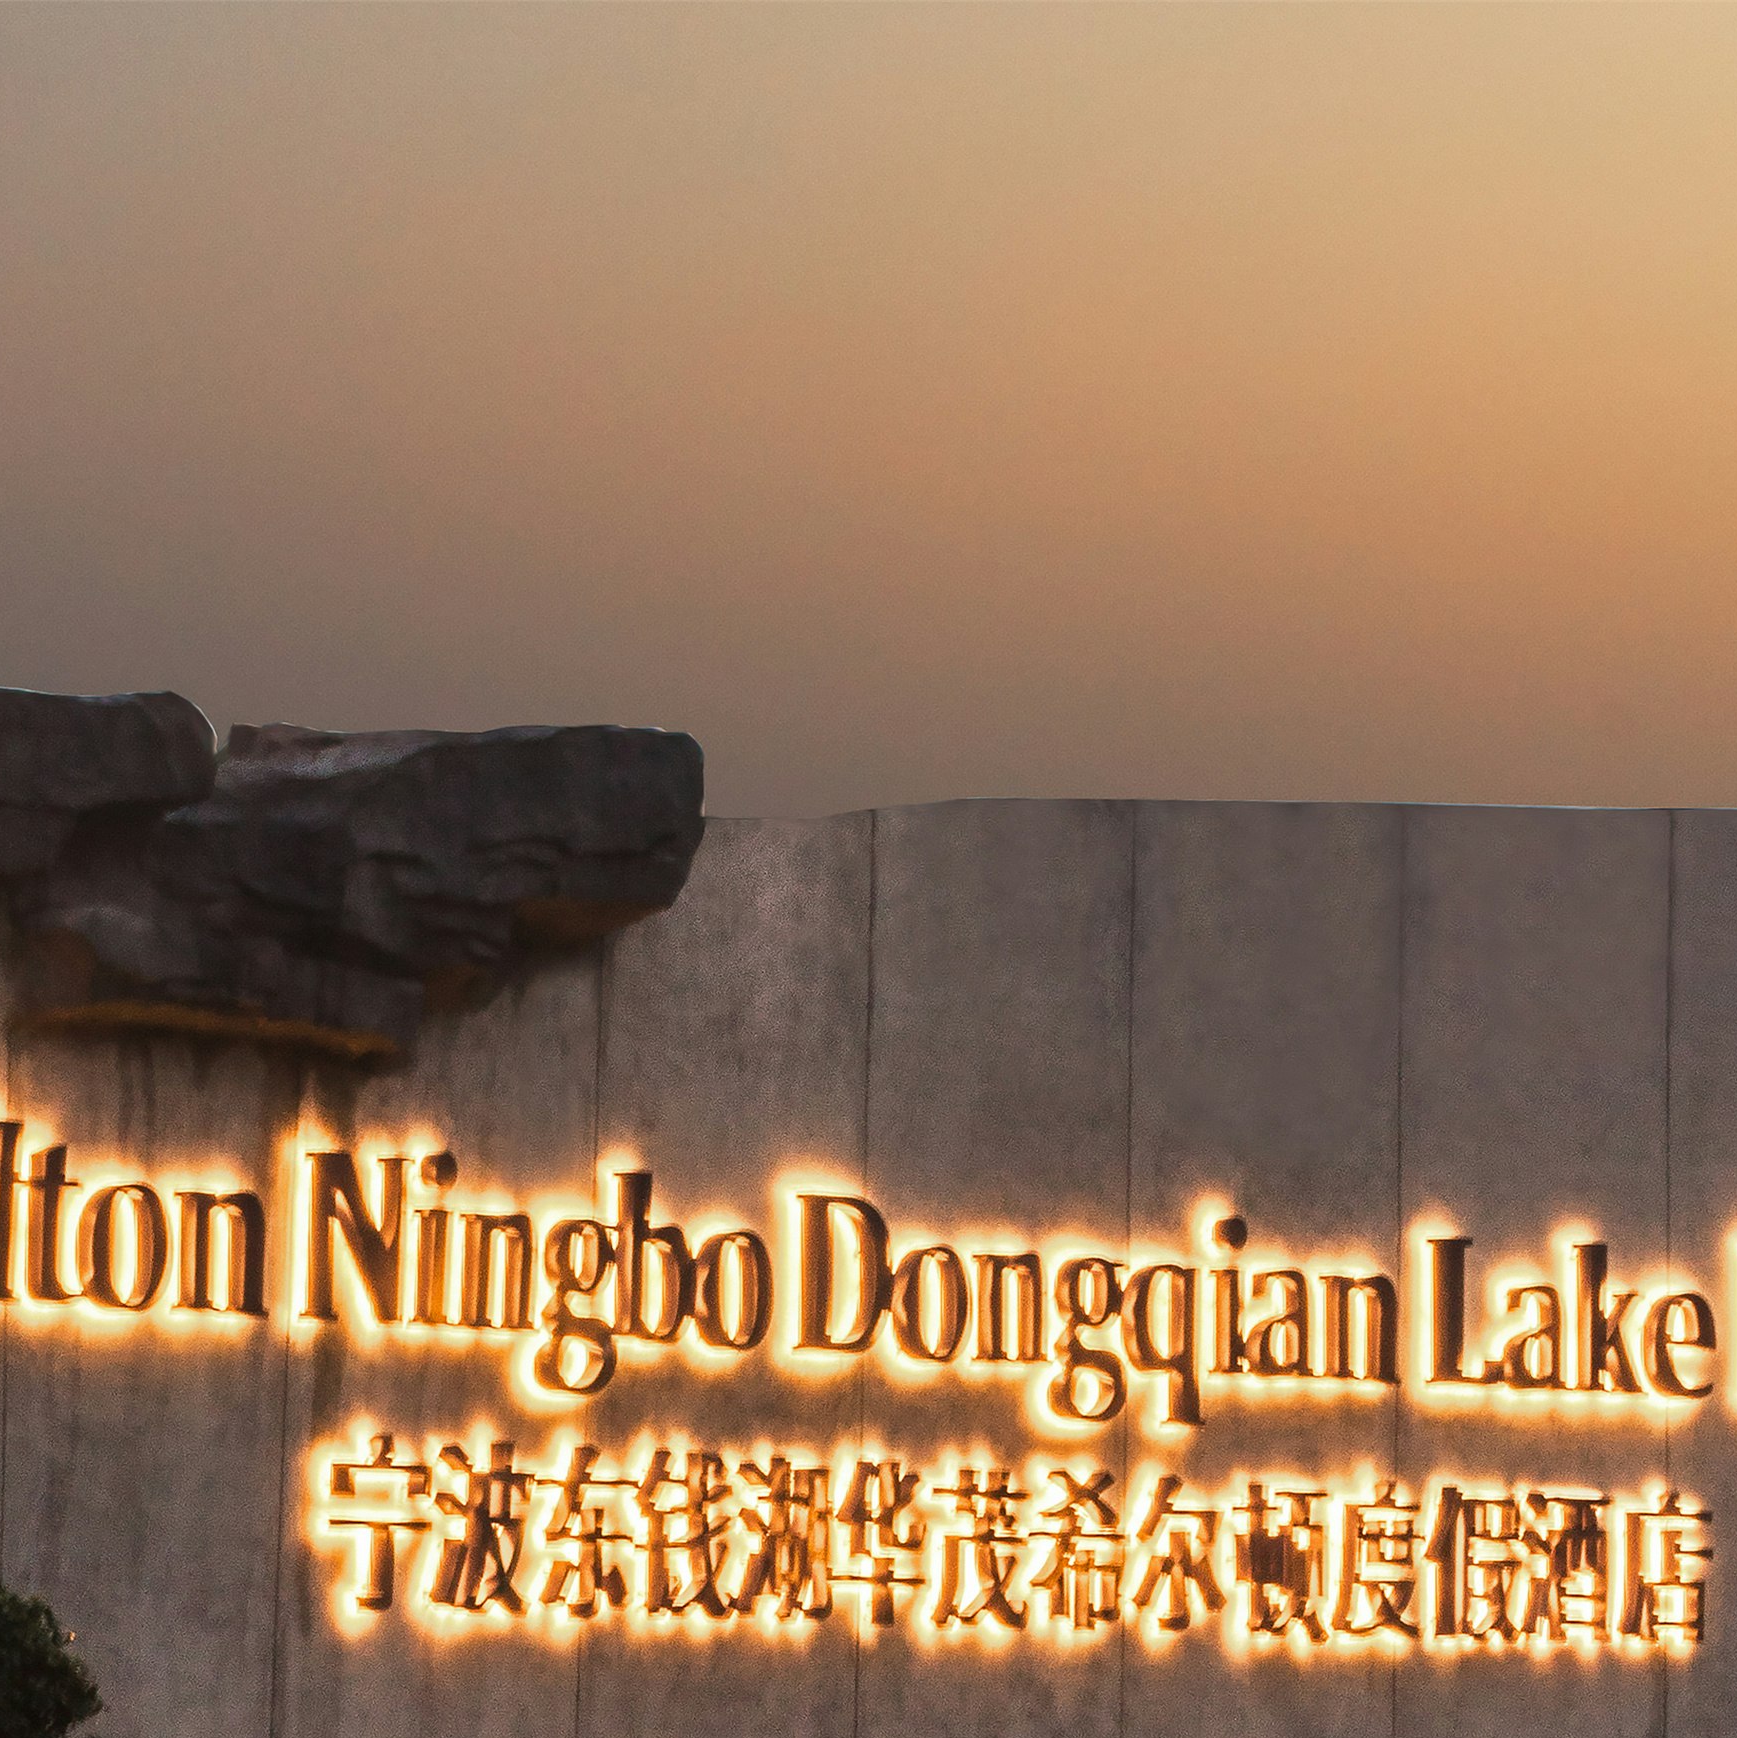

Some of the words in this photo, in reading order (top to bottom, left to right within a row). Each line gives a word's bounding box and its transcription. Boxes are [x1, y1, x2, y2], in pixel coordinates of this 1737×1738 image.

[299, 1149, 774, 1394] Ningbo
[793, 1190, 1400, 1426] Dongqian
[1426, 1235, 1717, 1401] Lake
